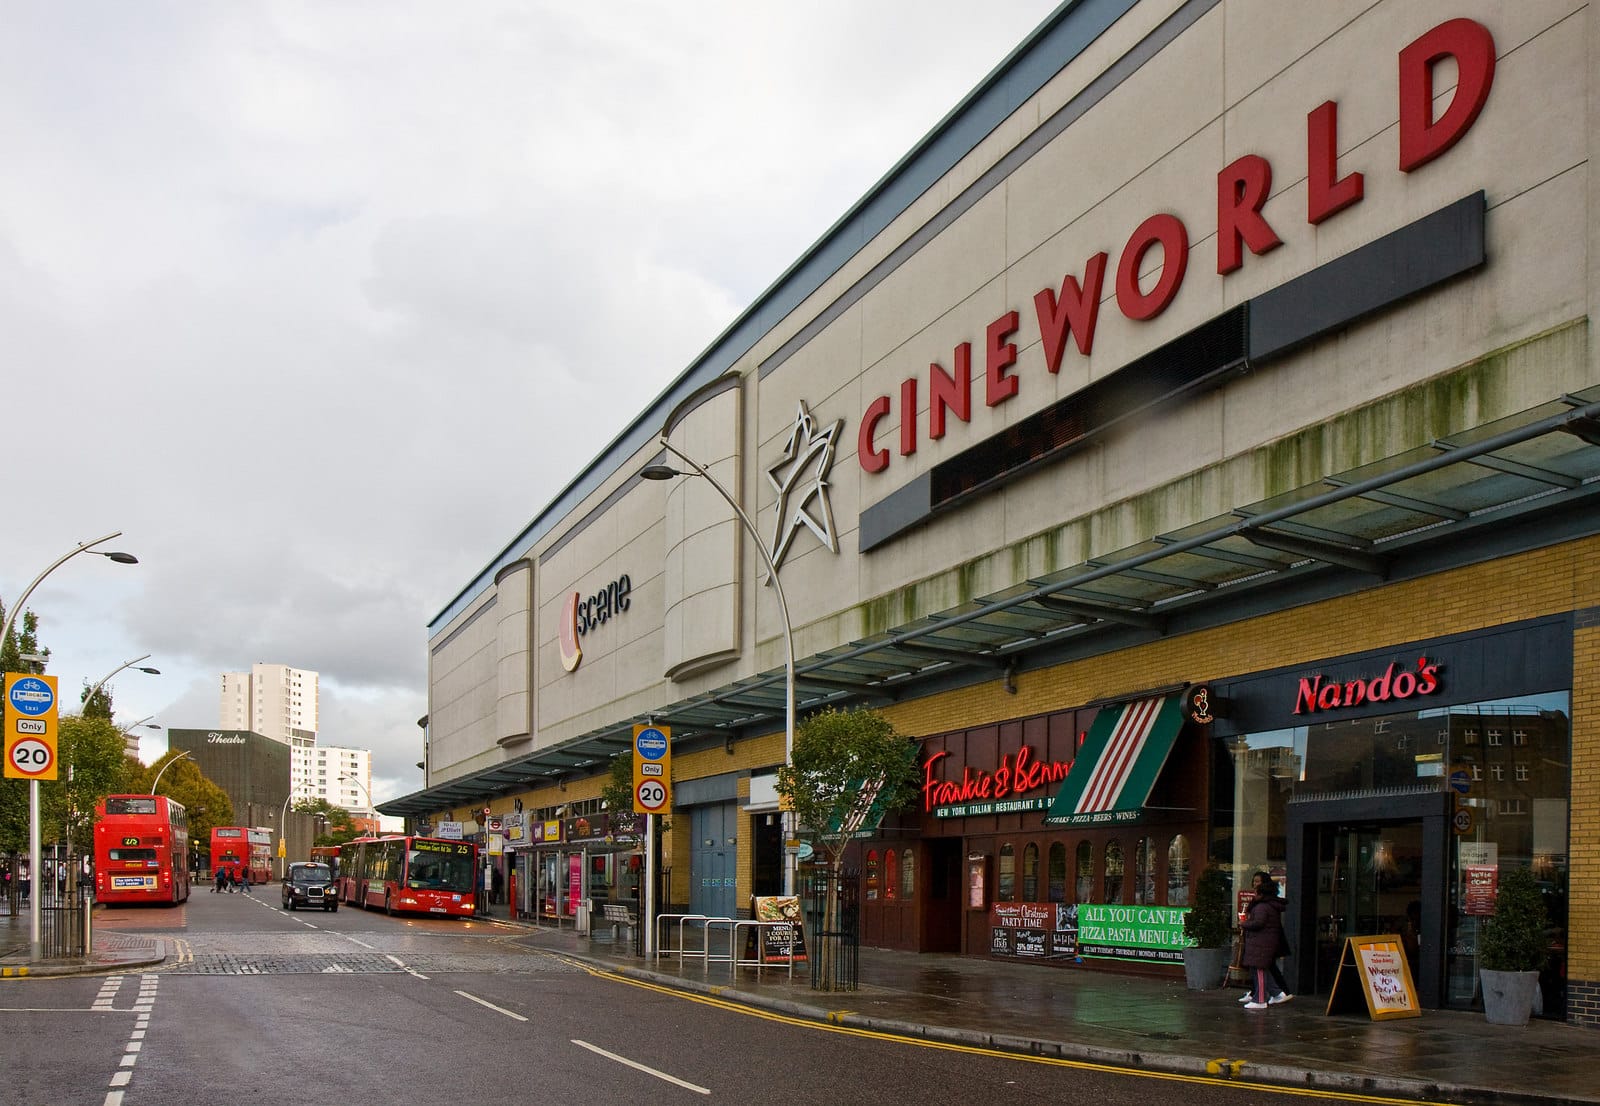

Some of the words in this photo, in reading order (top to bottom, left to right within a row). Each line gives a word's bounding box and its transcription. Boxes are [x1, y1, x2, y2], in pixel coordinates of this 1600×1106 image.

[857, 17, 1496, 474] CINEWORLD
[578, 574, 631, 636] scene
[1292, 656, 1438, 715] Nando's
[21, 722, 42, 731] Only
[207, 732, 246, 744] Theatre
[16, 748, 47, 764] 20
[644, 766, 660, 774] Only
[922, 752, 991, 813] Frankie
[641, 787, 663, 802] 20
[937, 808, 949, 817] NEW
[951, 806, 966, 815] YORK
[969, 804, 992, 814] ITALIAN
[995, 799, 1034, 811] RESTAURANT
[1071, 815, 1090, 823] PIZZA
[1092, 813, 1112, 822] BEERS
[1116, 811, 1137, 820] WINES
[457, 845, 468, 854] 25
[1020, 904, 1049, 918] Christmas
[1085, 908, 1106, 921] ALL
[1108, 909, 1135, 923] YOU
[1138, 910, 1166, 924] CAN
[1169, 910, 1192, 925] EA
[1001, 917, 1022, 927] PARTY
[1023, 918, 1042, 928] TIME!
[1080, 926, 1106, 940] PIZZA
[1108, 927, 1136, 942] PASTA
[1136, 929, 1169, 944] MENU
